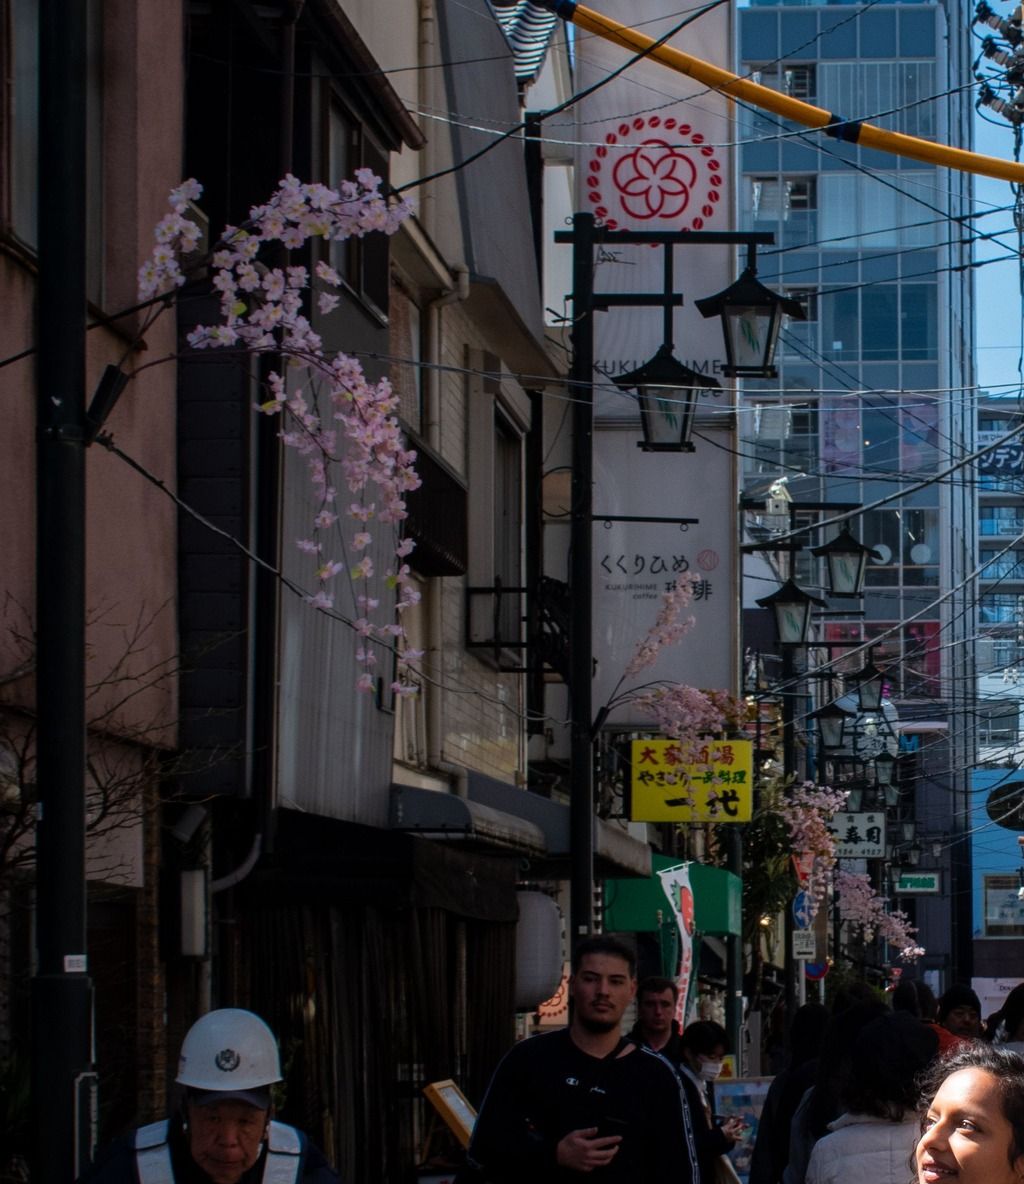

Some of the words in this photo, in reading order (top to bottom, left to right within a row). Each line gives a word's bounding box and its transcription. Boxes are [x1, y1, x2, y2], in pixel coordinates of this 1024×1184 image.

[600, 554, 690, 575] くくりひめ
